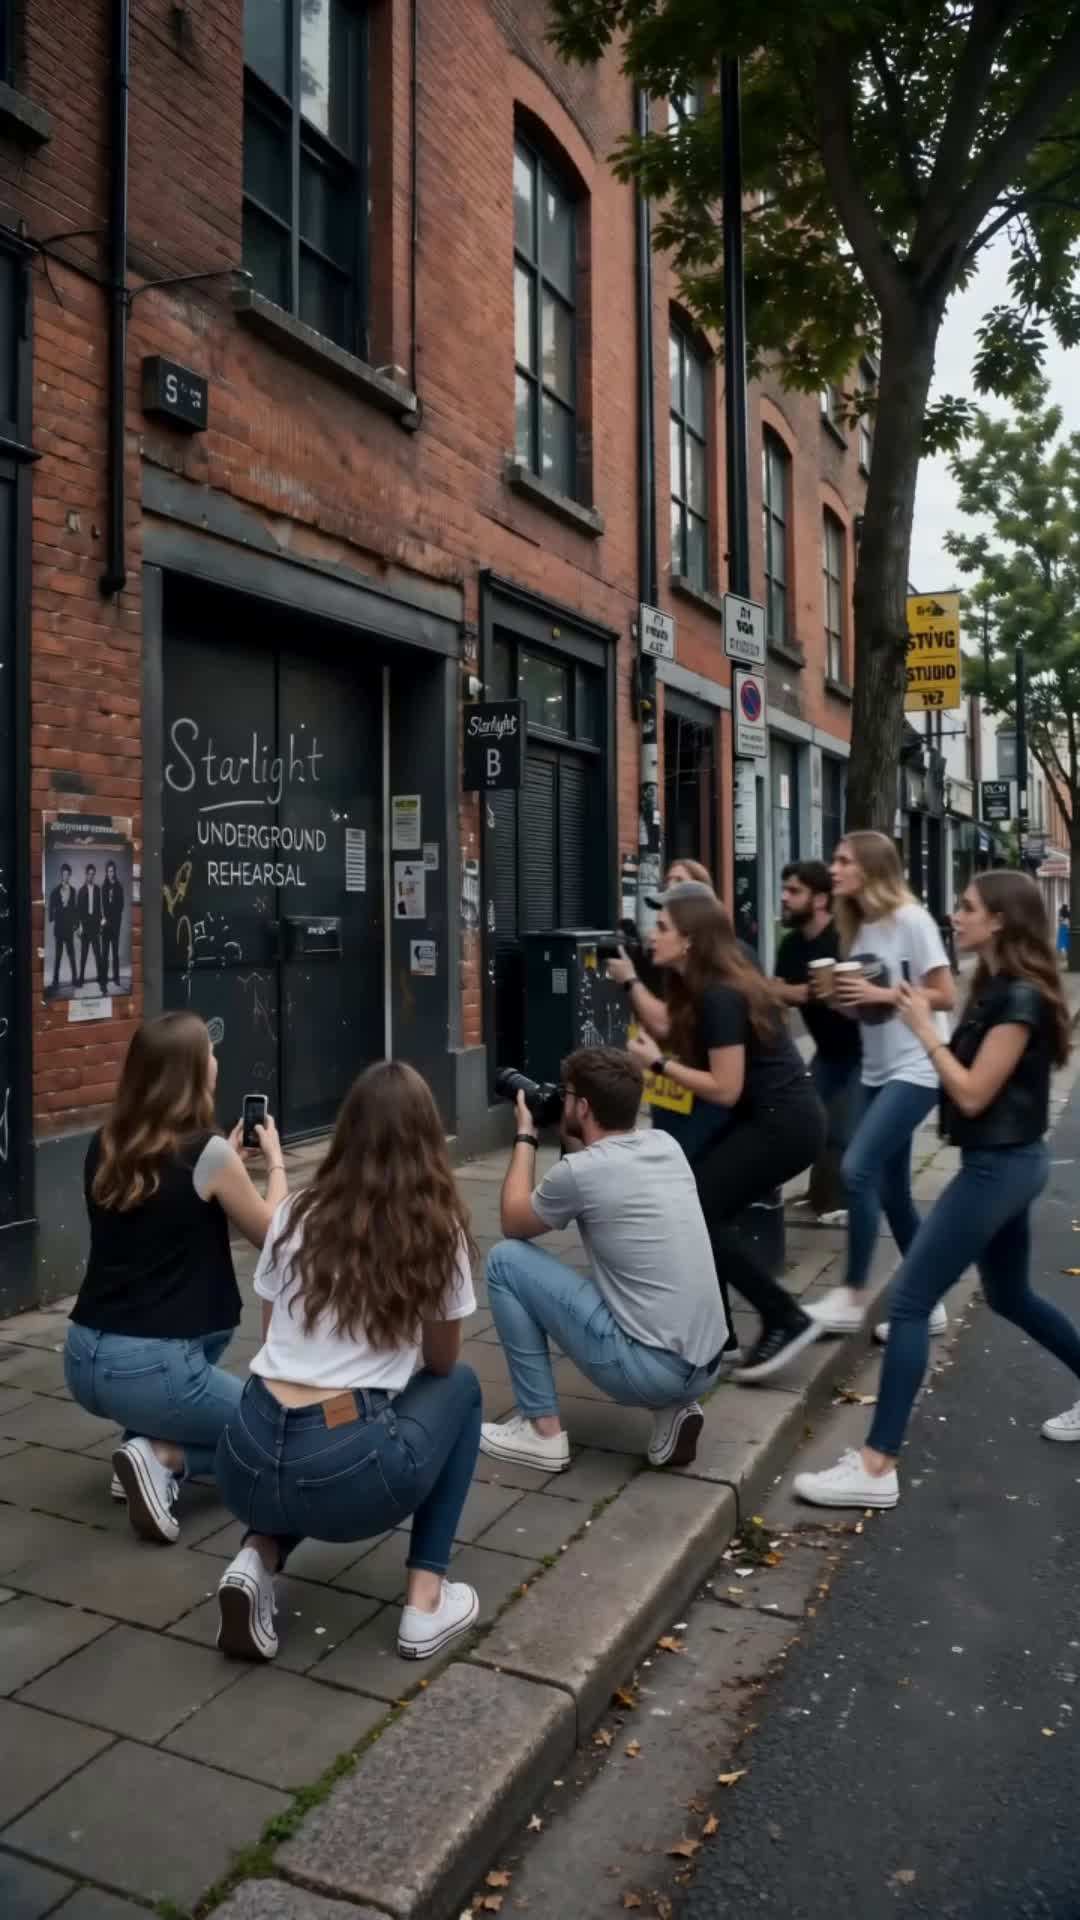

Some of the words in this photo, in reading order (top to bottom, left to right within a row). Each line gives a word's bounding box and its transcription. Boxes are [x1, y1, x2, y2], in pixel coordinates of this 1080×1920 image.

[906, 664, 956, 682] STUDIO
[165, 717, 324, 804] Starlight
[487, 748, 501, 777] B
[197, 820, 327, 852] UNDERGROUND
[207, 860, 307, 887] REHEARSAL
